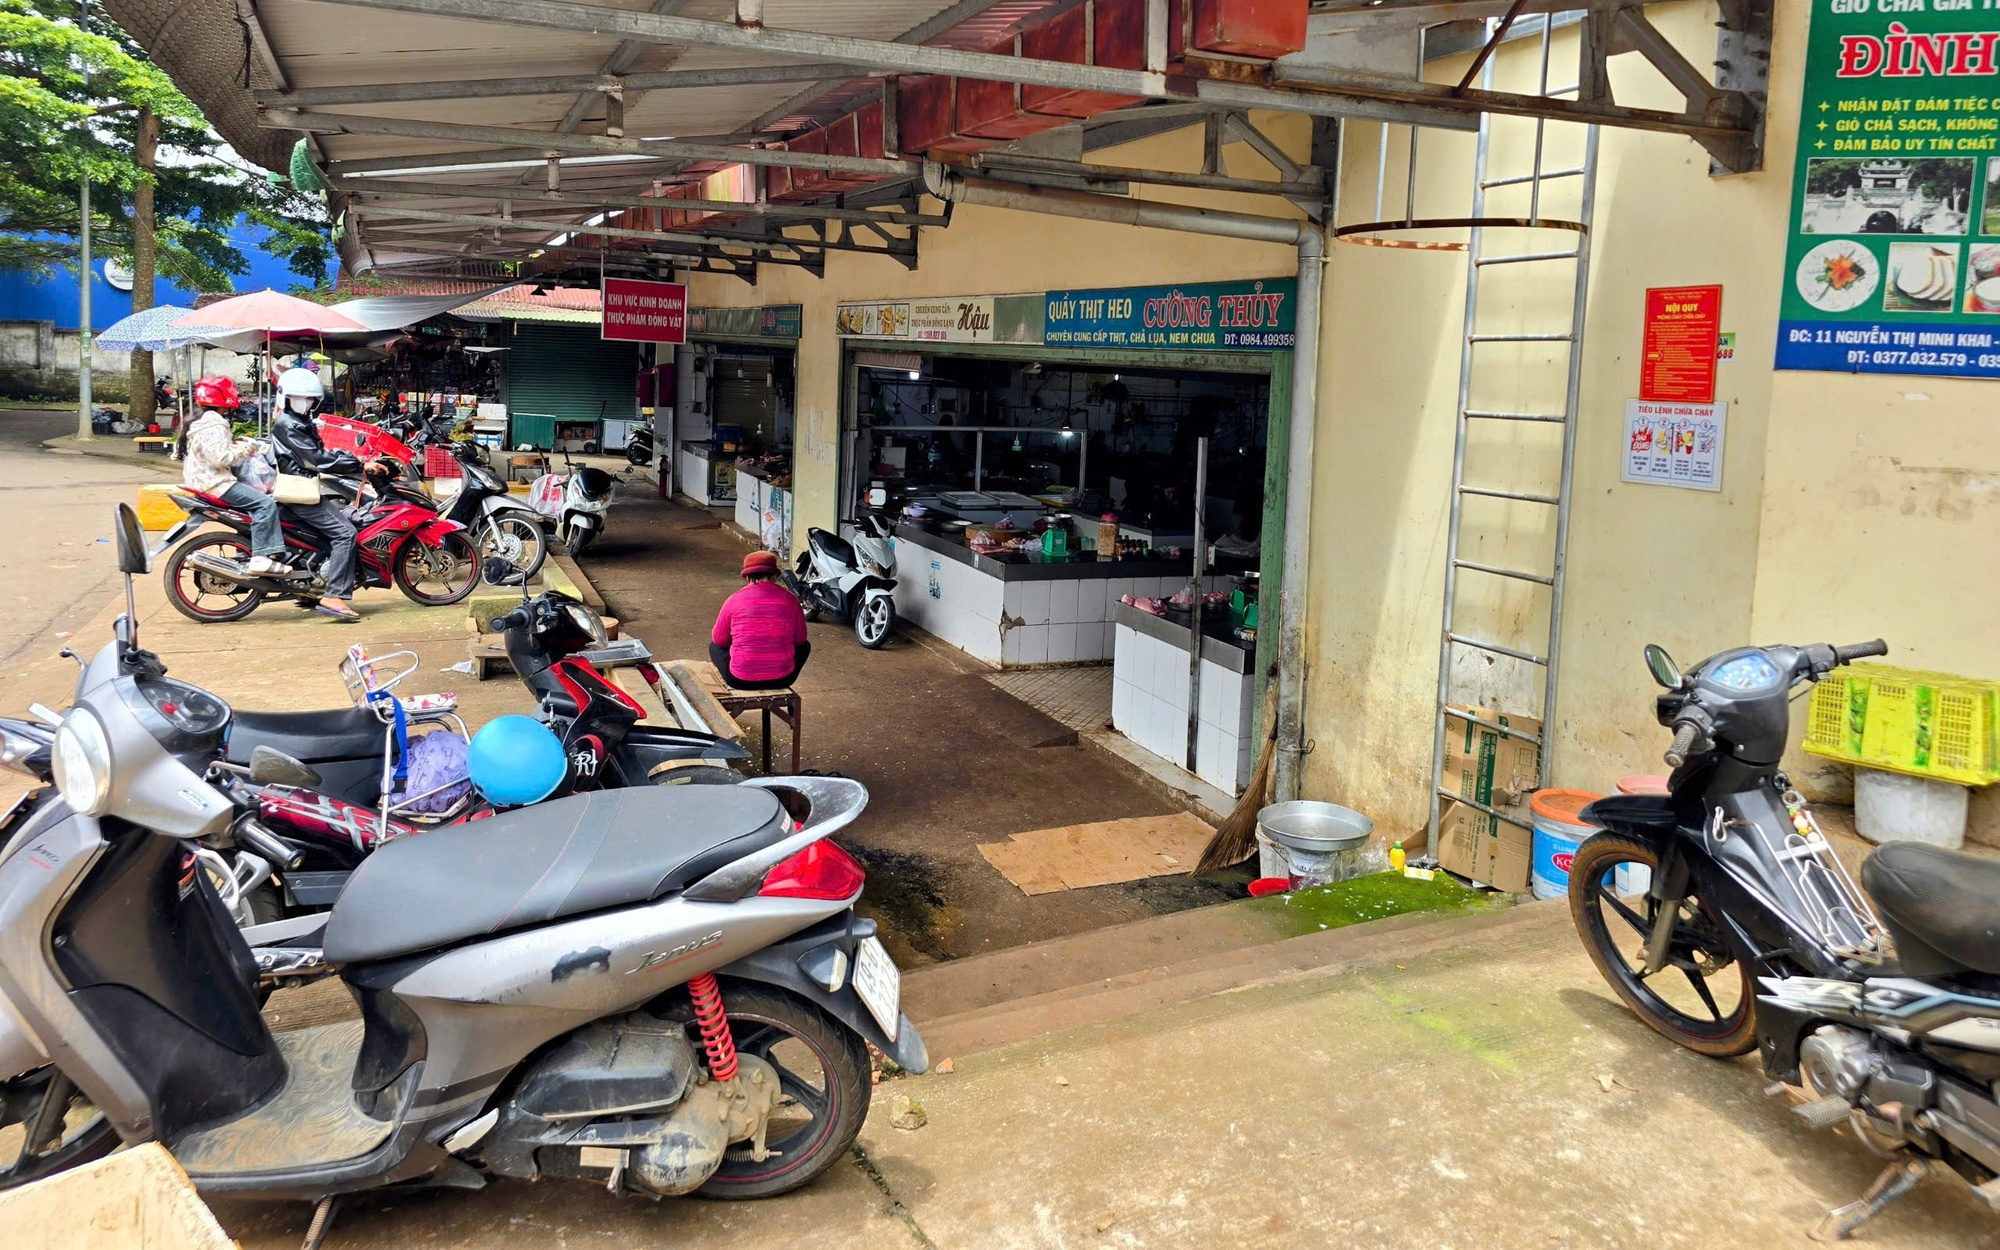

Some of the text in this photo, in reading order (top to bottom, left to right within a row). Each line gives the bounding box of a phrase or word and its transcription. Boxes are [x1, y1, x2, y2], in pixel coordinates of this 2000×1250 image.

[1836, 21, 2000, 78] ĐÌNH
[1837, 97, 1878, 114] NHẬN
[1915, 96, 1950, 111] ĐÁM
[1953, 95, 1989, 112] TIỆC
[1864, 115, 1893, 131] CHẢ
[1897, 118, 1942, 133] SẠCH,
[1945, 116, 1999, 131] KHÔNG
[1870, 134, 1902, 151] BẢO
[1904, 139, 1925, 150] UY
[1929, 135, 1954, 150] TÍN
[1956, 133, 1998, 150] CHẤT
[607, 293, 683, 310] KHU VỰC KINH DOANH
[1048, 281, 1284, 328] QUẦY THỊT HEO CƯỜNG THỦY
[1665, 303, 1699, 313] NỘI QUY
[606, 310, 625, 326] THỰC
[626, 308, 647, 325] PHẨM
[648, 312, 668, 328] ĐỘNG
[669, 313, 682, 330] VẬT
[957, 303, 990, 338] Hậu
[1046, 328, 1216, 346] CHUYÊN CUNG CẤP THỊT, CHẢ LỤA, NEM CHUA
[1223, 333, 1239, 346] ĐT:
[1789, 329, 1812, 343] ĐC:
[1815, 330, 1832, 343] 11
[1835, 325, 1890, 345] NGUYỄN
[1892, 331, 1915, 348] THỊ
[1918, 332, 1955, 346] MINH
[1957, 333, 1992, 347] KHAI
[1847, 350, 1870, 364] ĐT:
[1872, 351, 1967, 366] 0377.032.579
[1661, 419, 1667, 427] 2
[1682, 420, 1688, 428] 3
